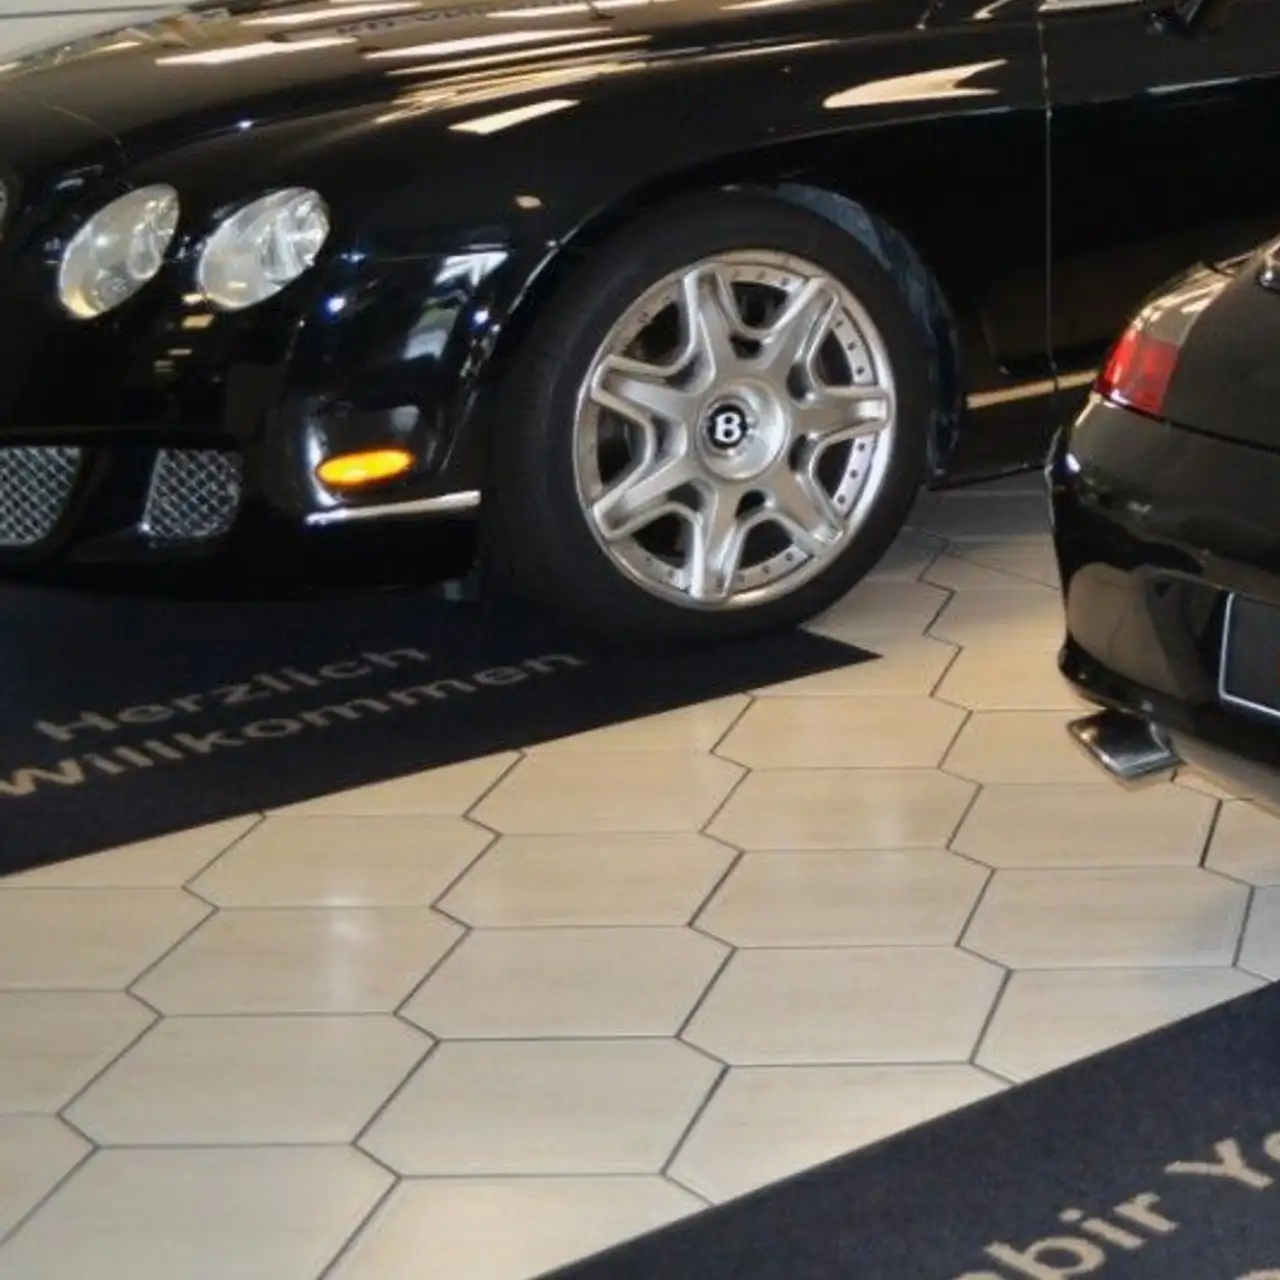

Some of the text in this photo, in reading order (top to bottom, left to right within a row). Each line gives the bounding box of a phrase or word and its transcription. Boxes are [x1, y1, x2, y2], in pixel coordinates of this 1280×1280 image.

[0, 651, 590, 797] Willkommen
[35, 646, 432, 742] Herzlich
[952, 1191, 1178, 1280] bir
